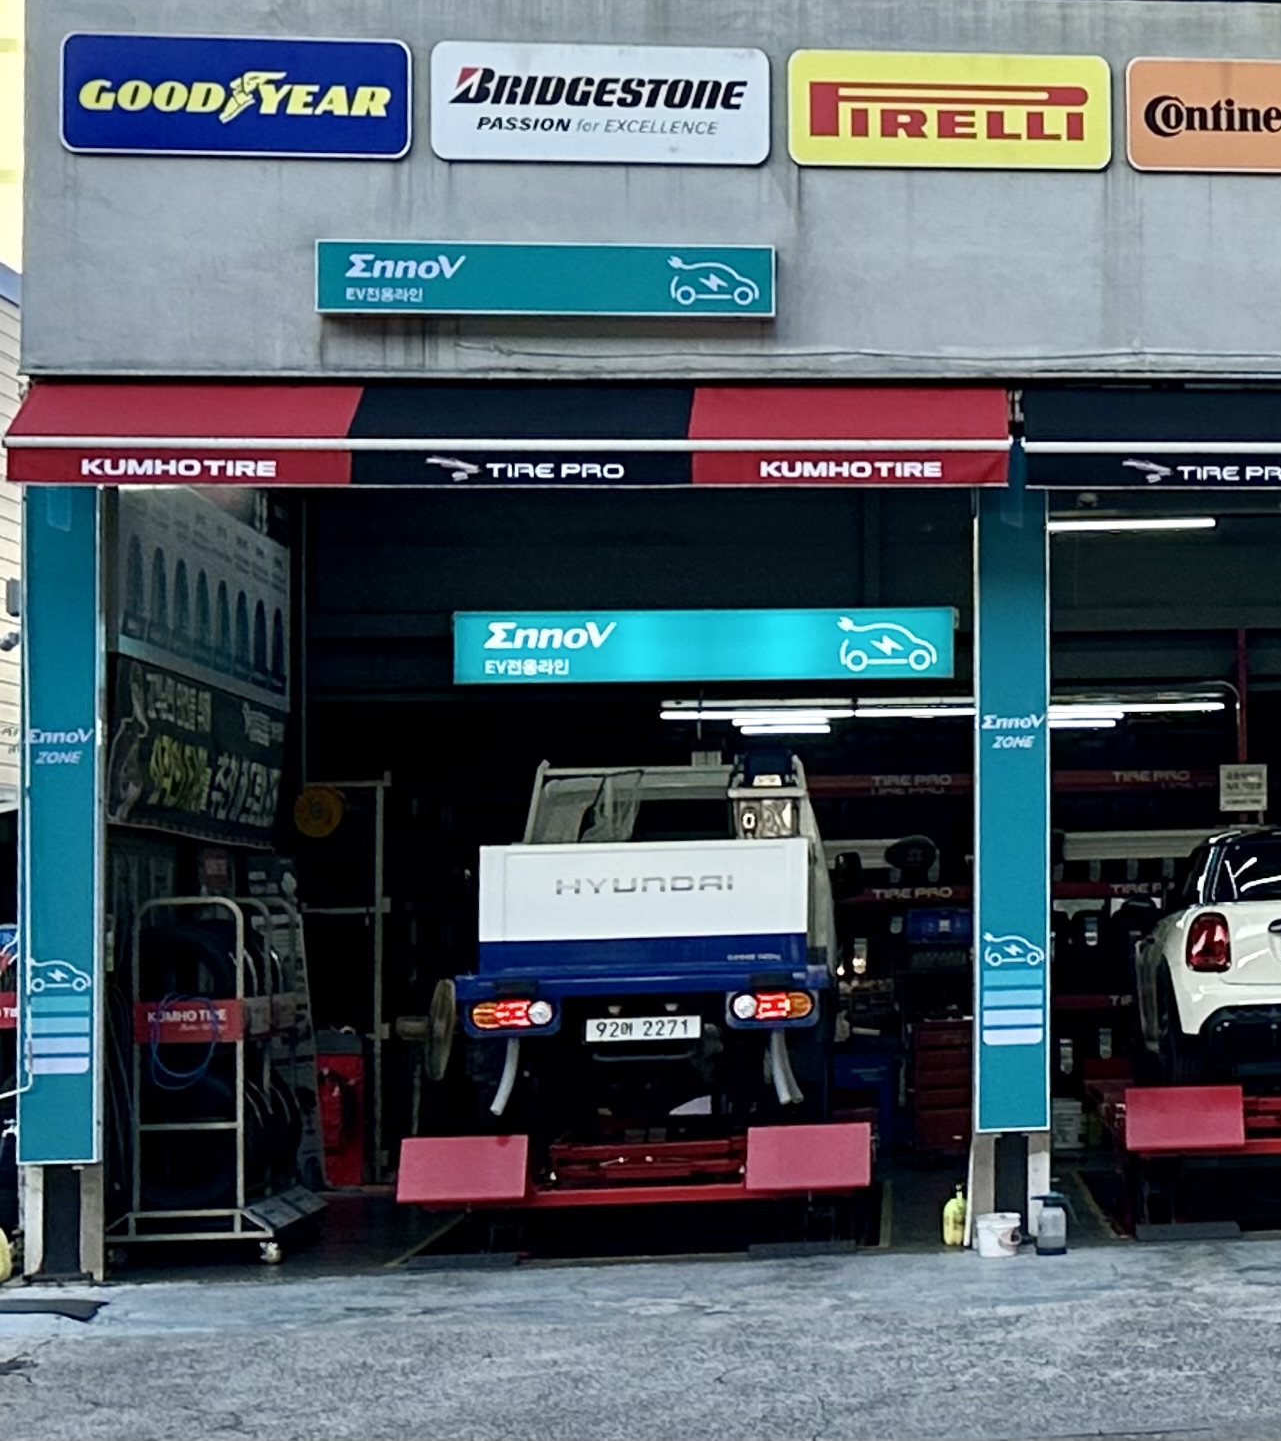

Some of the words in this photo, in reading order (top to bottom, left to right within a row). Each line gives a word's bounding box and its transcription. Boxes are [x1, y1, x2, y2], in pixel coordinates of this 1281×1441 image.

[449, 66, 748, 111] BRIDGESTONE
[810, 80, 1088, 141] PIRELLI
[477, 115, 571, 133] PASSION
[576, 118, 600, 134] for
[604, 118, 719, 136] EXCELLENCE
[485, 461, 556, 480] TIRE
[560, 462, 624, 480] PRO
[1176, 464, 1245, 482] TIRE
[484, 658, 570, 676] EV전용라인
[992, 736, 1036, 749] ZONE
[35, 750, 82, 765] ZONE
[555, 874, 734, 896] HYUNDAI
[643, 1019, 688, 1037] 2271
